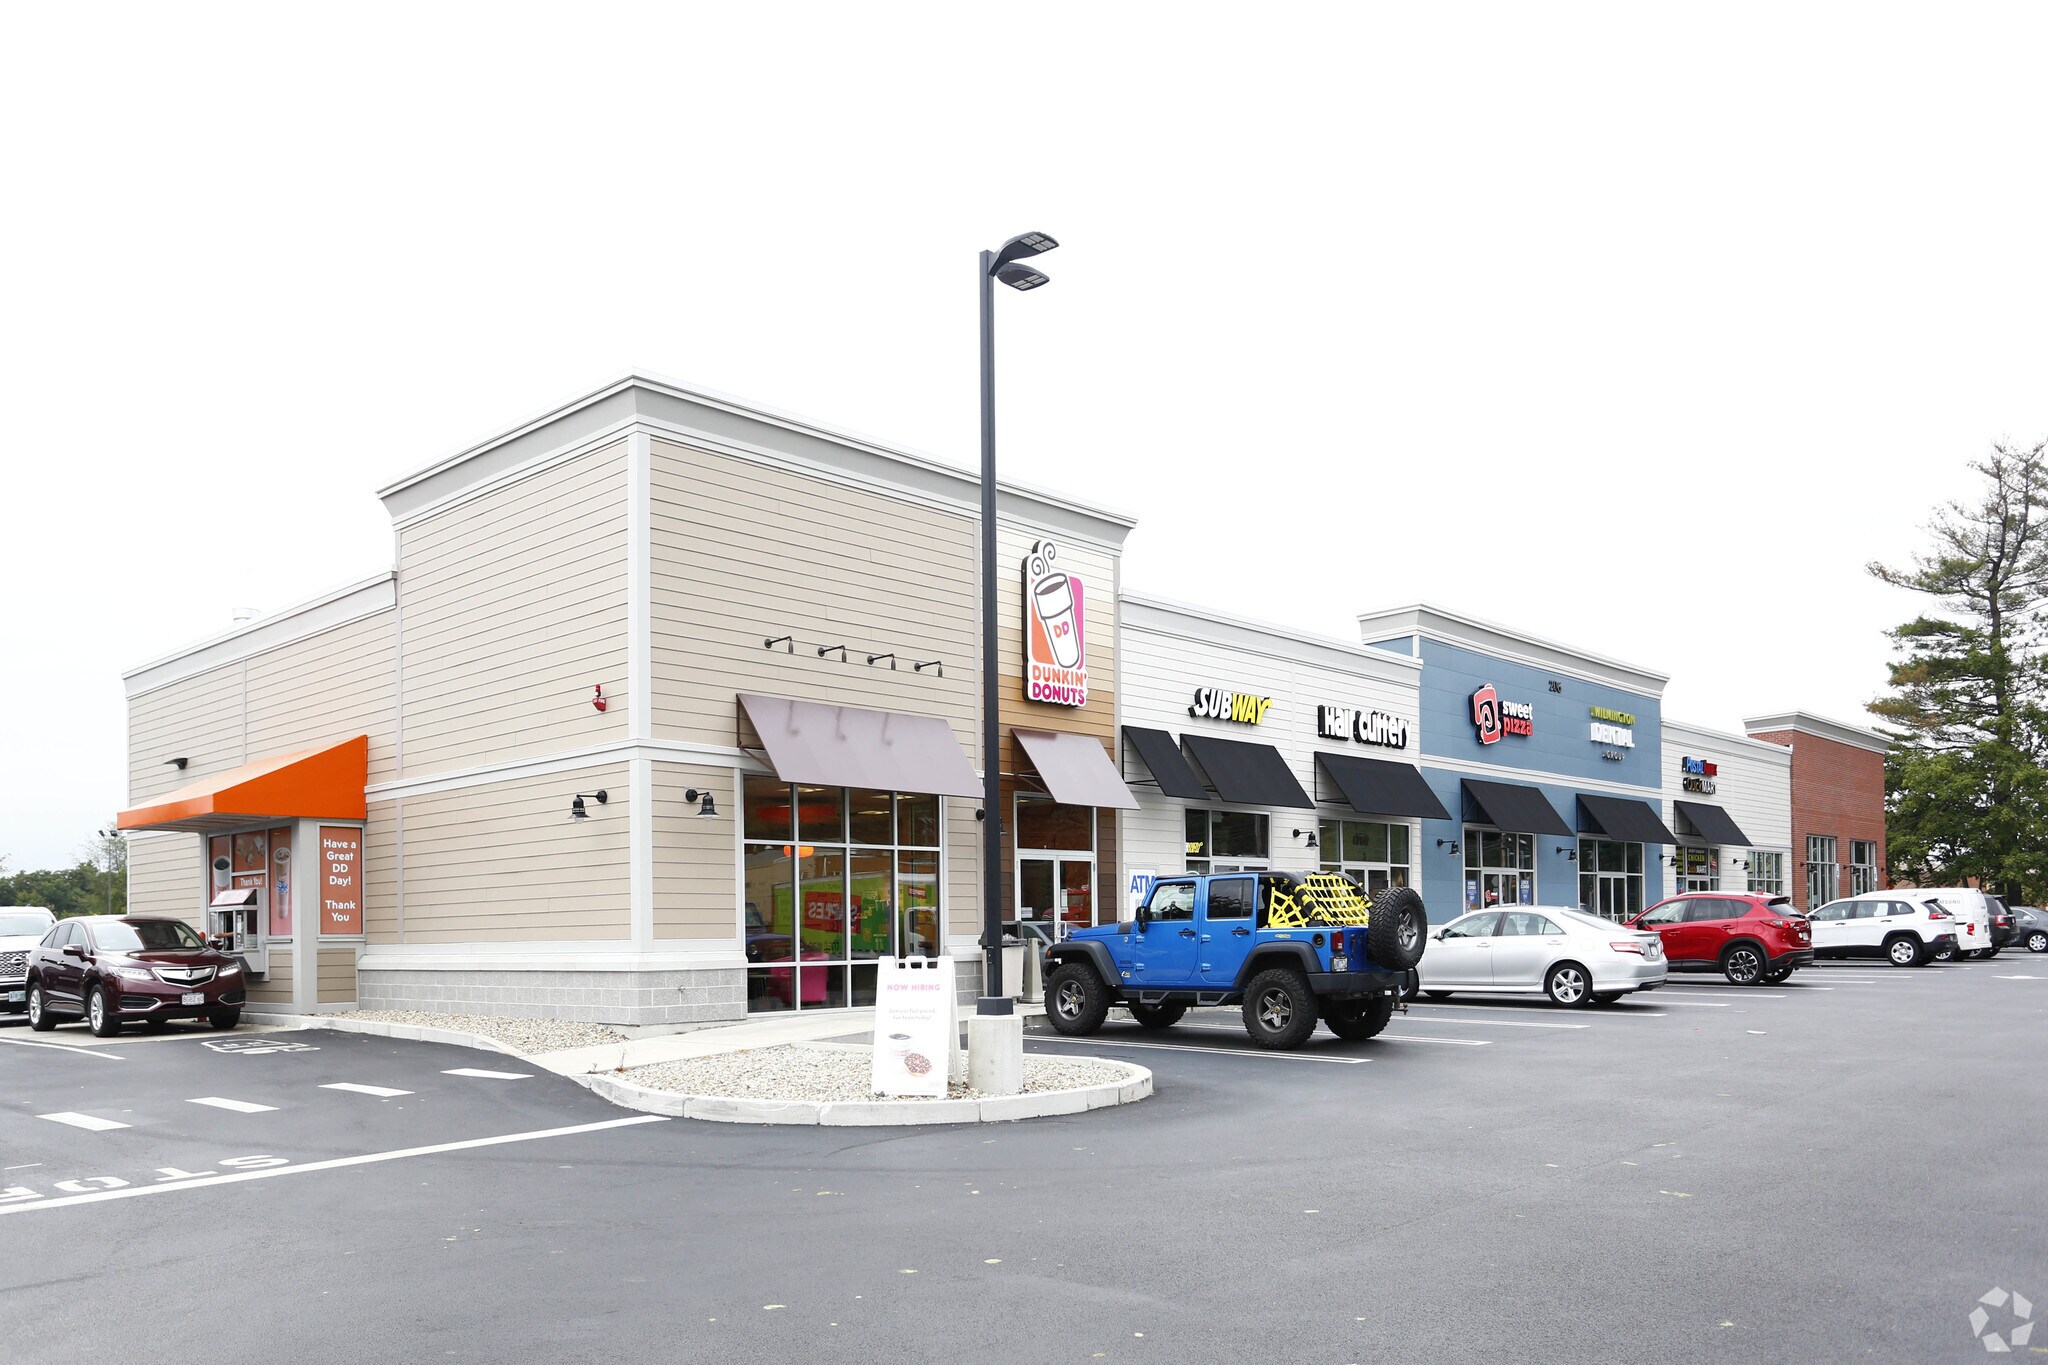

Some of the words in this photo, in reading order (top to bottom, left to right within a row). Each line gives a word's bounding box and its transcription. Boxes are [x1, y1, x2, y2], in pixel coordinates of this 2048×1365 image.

[1053, 621, 1069, 638] DD
[1032, 664, 1087, 687] DUNKIN'
[1032, 682, 1085, 705] DONUTS
[1191, 687, 1273, 725] SUBWAY
[1502, 700, 1534, 720] sweet
[1324, 706, 1356, 740] Hair
[1592, 707, 1635, 725] WILMINGTON
[1502, 716, 1534, 736] pizza
[1591, 723, 1635, 748] DENTAL
[323, 839, 348, 849] Have
[326, 851, 354, 861] Great
[332, 864, 348, 872] DD
[240, 877, 255, 886] Thank
[329, 876, 352, 886] Day!
[325, 900, 356, 910] Thank
[331, 913, 349, 922] You
